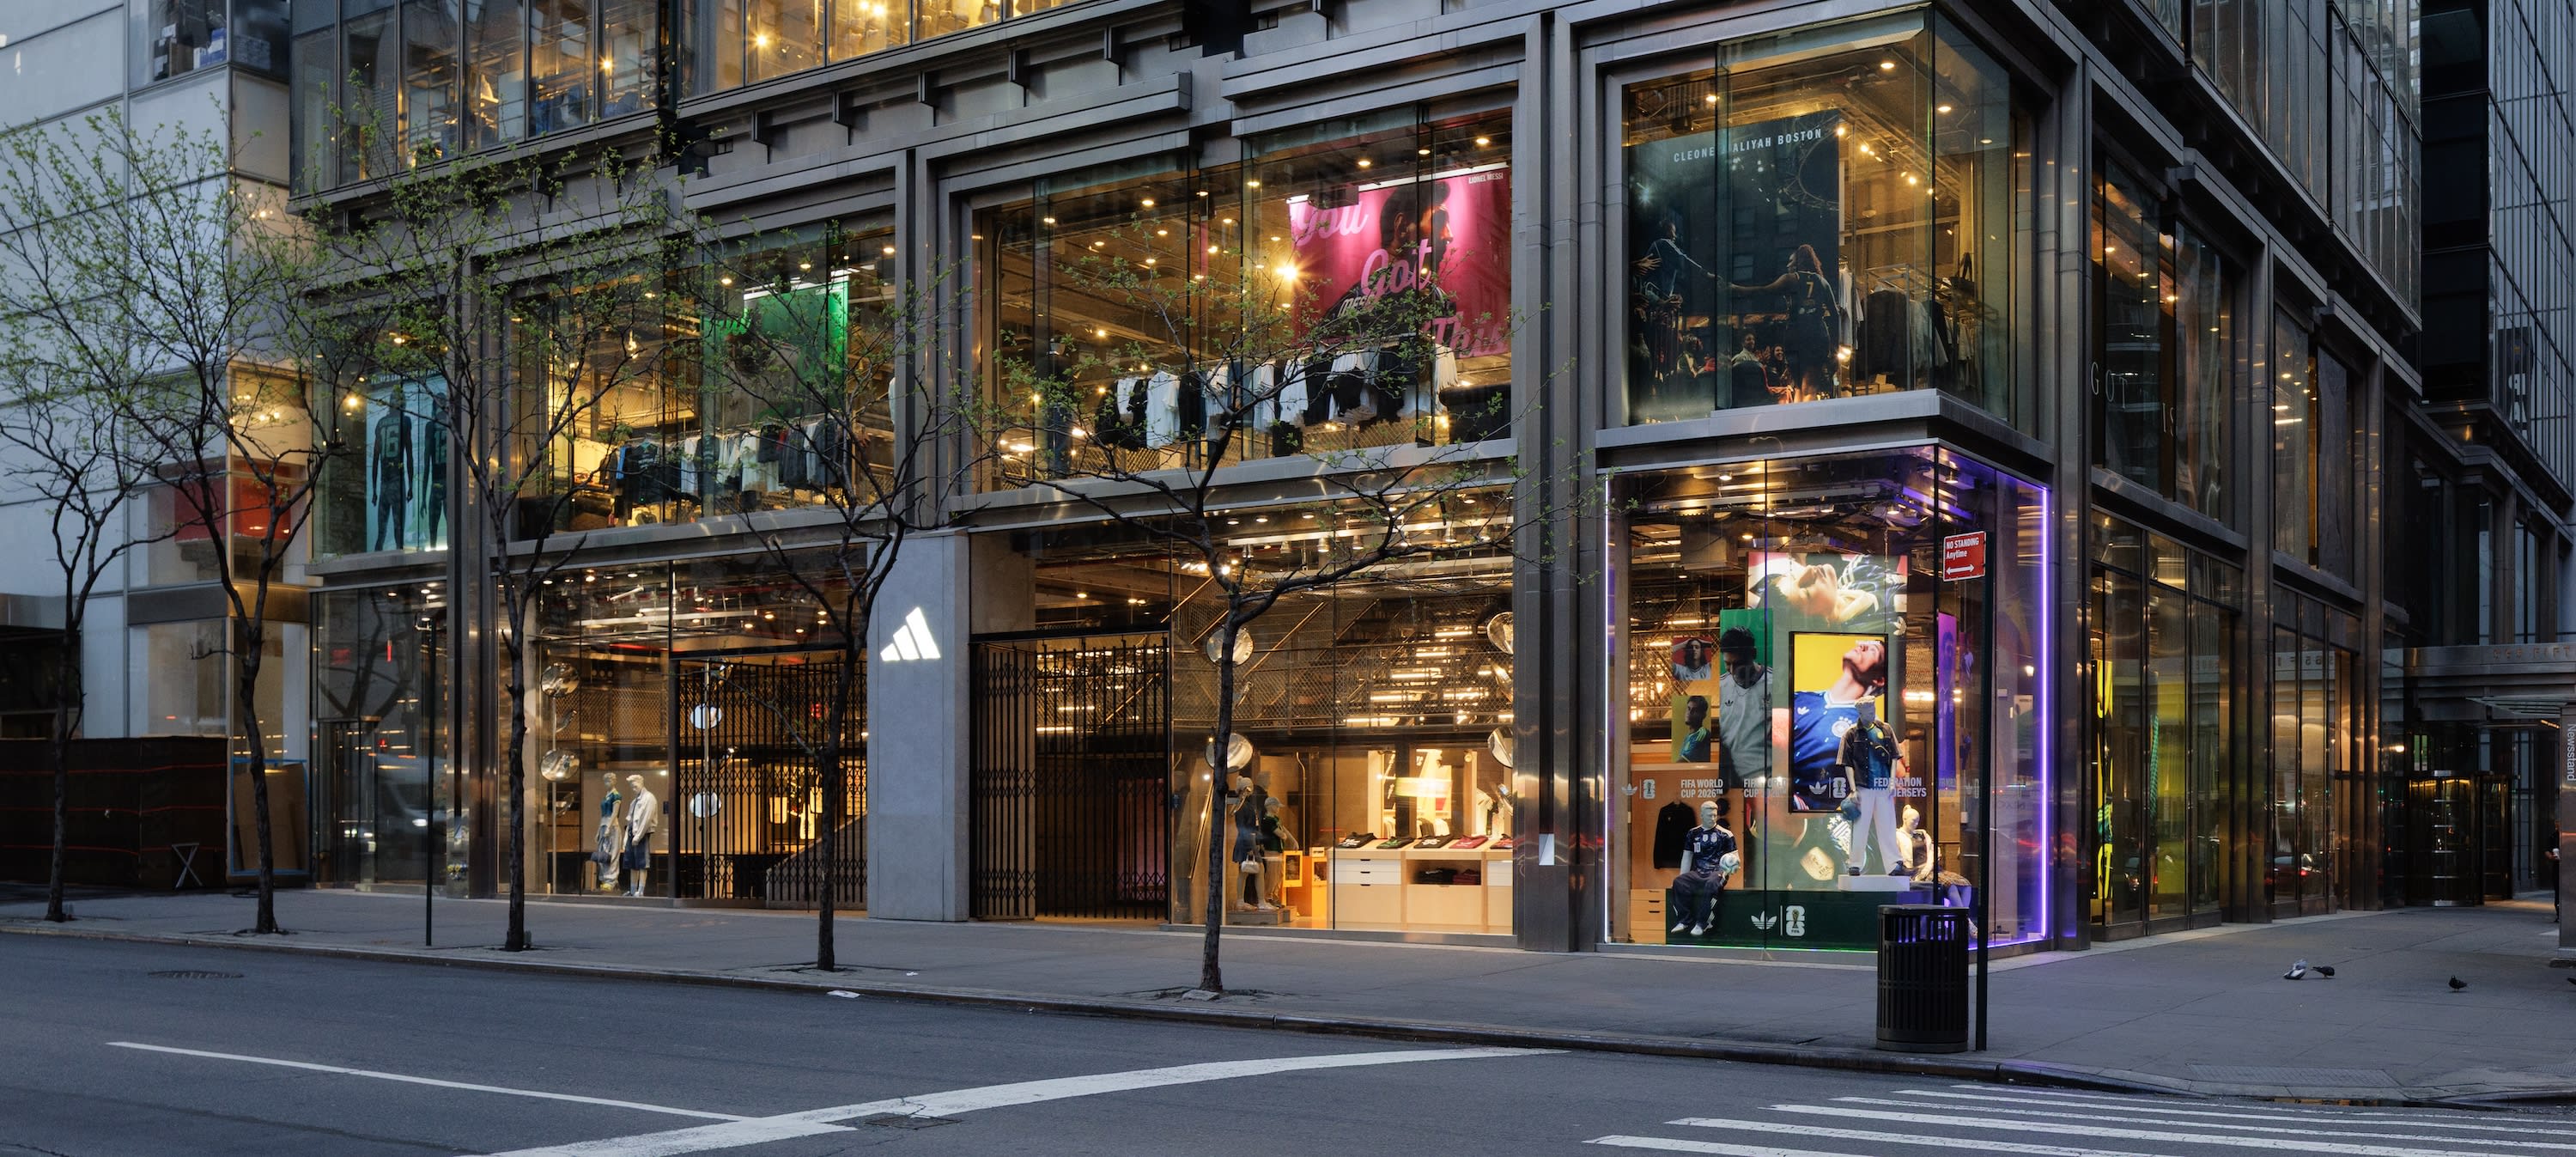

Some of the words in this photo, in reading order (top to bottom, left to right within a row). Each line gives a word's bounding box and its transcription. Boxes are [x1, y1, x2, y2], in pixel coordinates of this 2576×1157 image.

[1732, 137, 1771, 153] ALIYAH
[1777, 128, 1821, 145] BOSTON
[1468, 174, 1486, 184] LIONEL
[1487, 172, 1504, 180] MESSI
[1360, 239, 1432, 302] Got
[1806, 281, 1814, 298] 7
[2091, 362, 2128, 409] GOT
[380, 426, 400, 458] 16
[1947, 541, 1953, 550] NO
[1954, 538, 1978, 548] STANDING
[1947, 550, 1967, 560] Anytime
[2567, 723, 2576, 781] Newsstand
[1680, 778, 1696, 789] FIFA
[1697, 778, 1724, 789] WORLD
[1744, 777, 1759, 788] FIFA
[1680, 789, 1696, 798] CUP
[1744, 789, 1759, 797] CUP
[1692, 842, 1701, 853] 10
